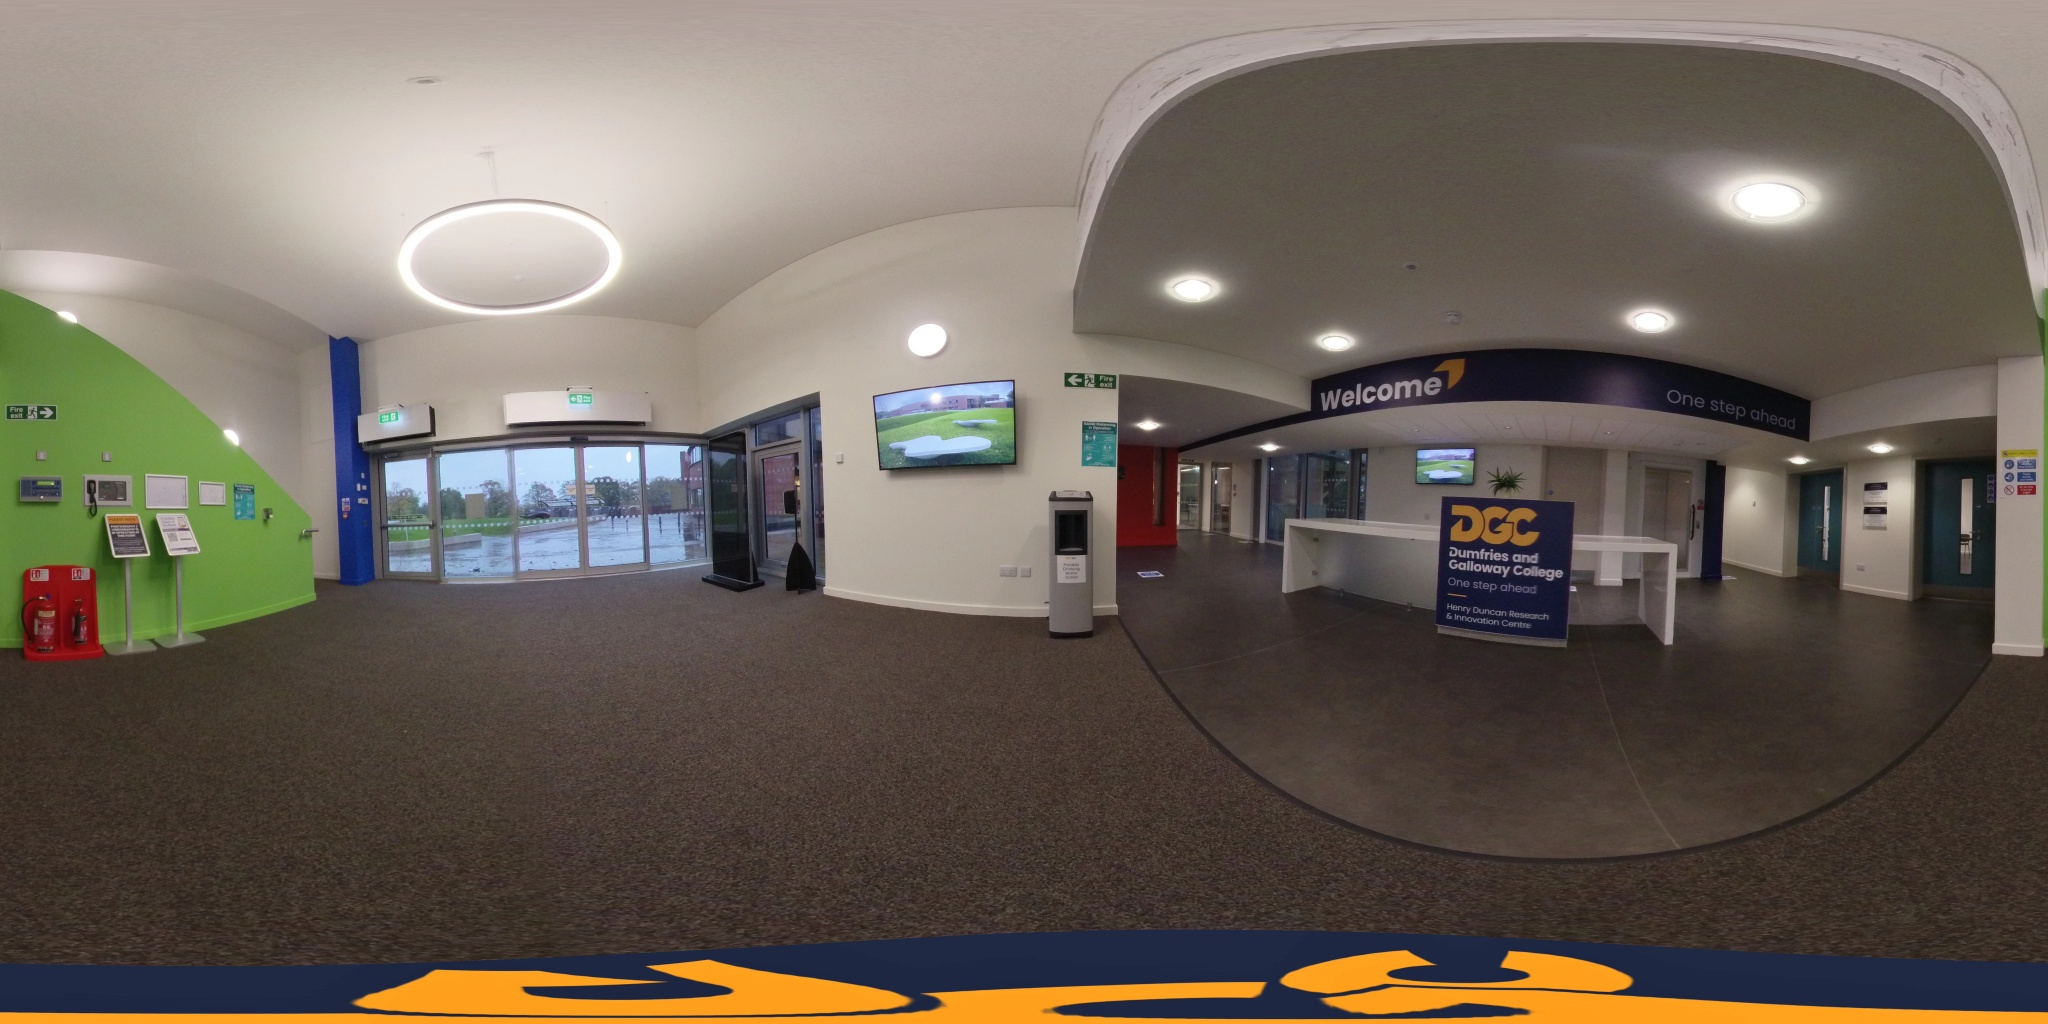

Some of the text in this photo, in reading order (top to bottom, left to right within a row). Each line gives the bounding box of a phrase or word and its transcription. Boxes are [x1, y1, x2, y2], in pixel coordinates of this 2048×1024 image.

[1320, 376, 1442, 411] Welcome
[1666, 389, 1796, 430] One step ahead
[1450, 504, 1540, 547] DGC
[1449, 546, 1540, 564] Dumfries and
[1448, 560, 1564, 582] Galloway College
[1448, 577, 1538, 594] One step ahead
[1446, 602, 1550, 620] Henry Duncan Research
[1454, 613, 1500, 626] Innovation
[1502, 620, 1532, 629] Centre
